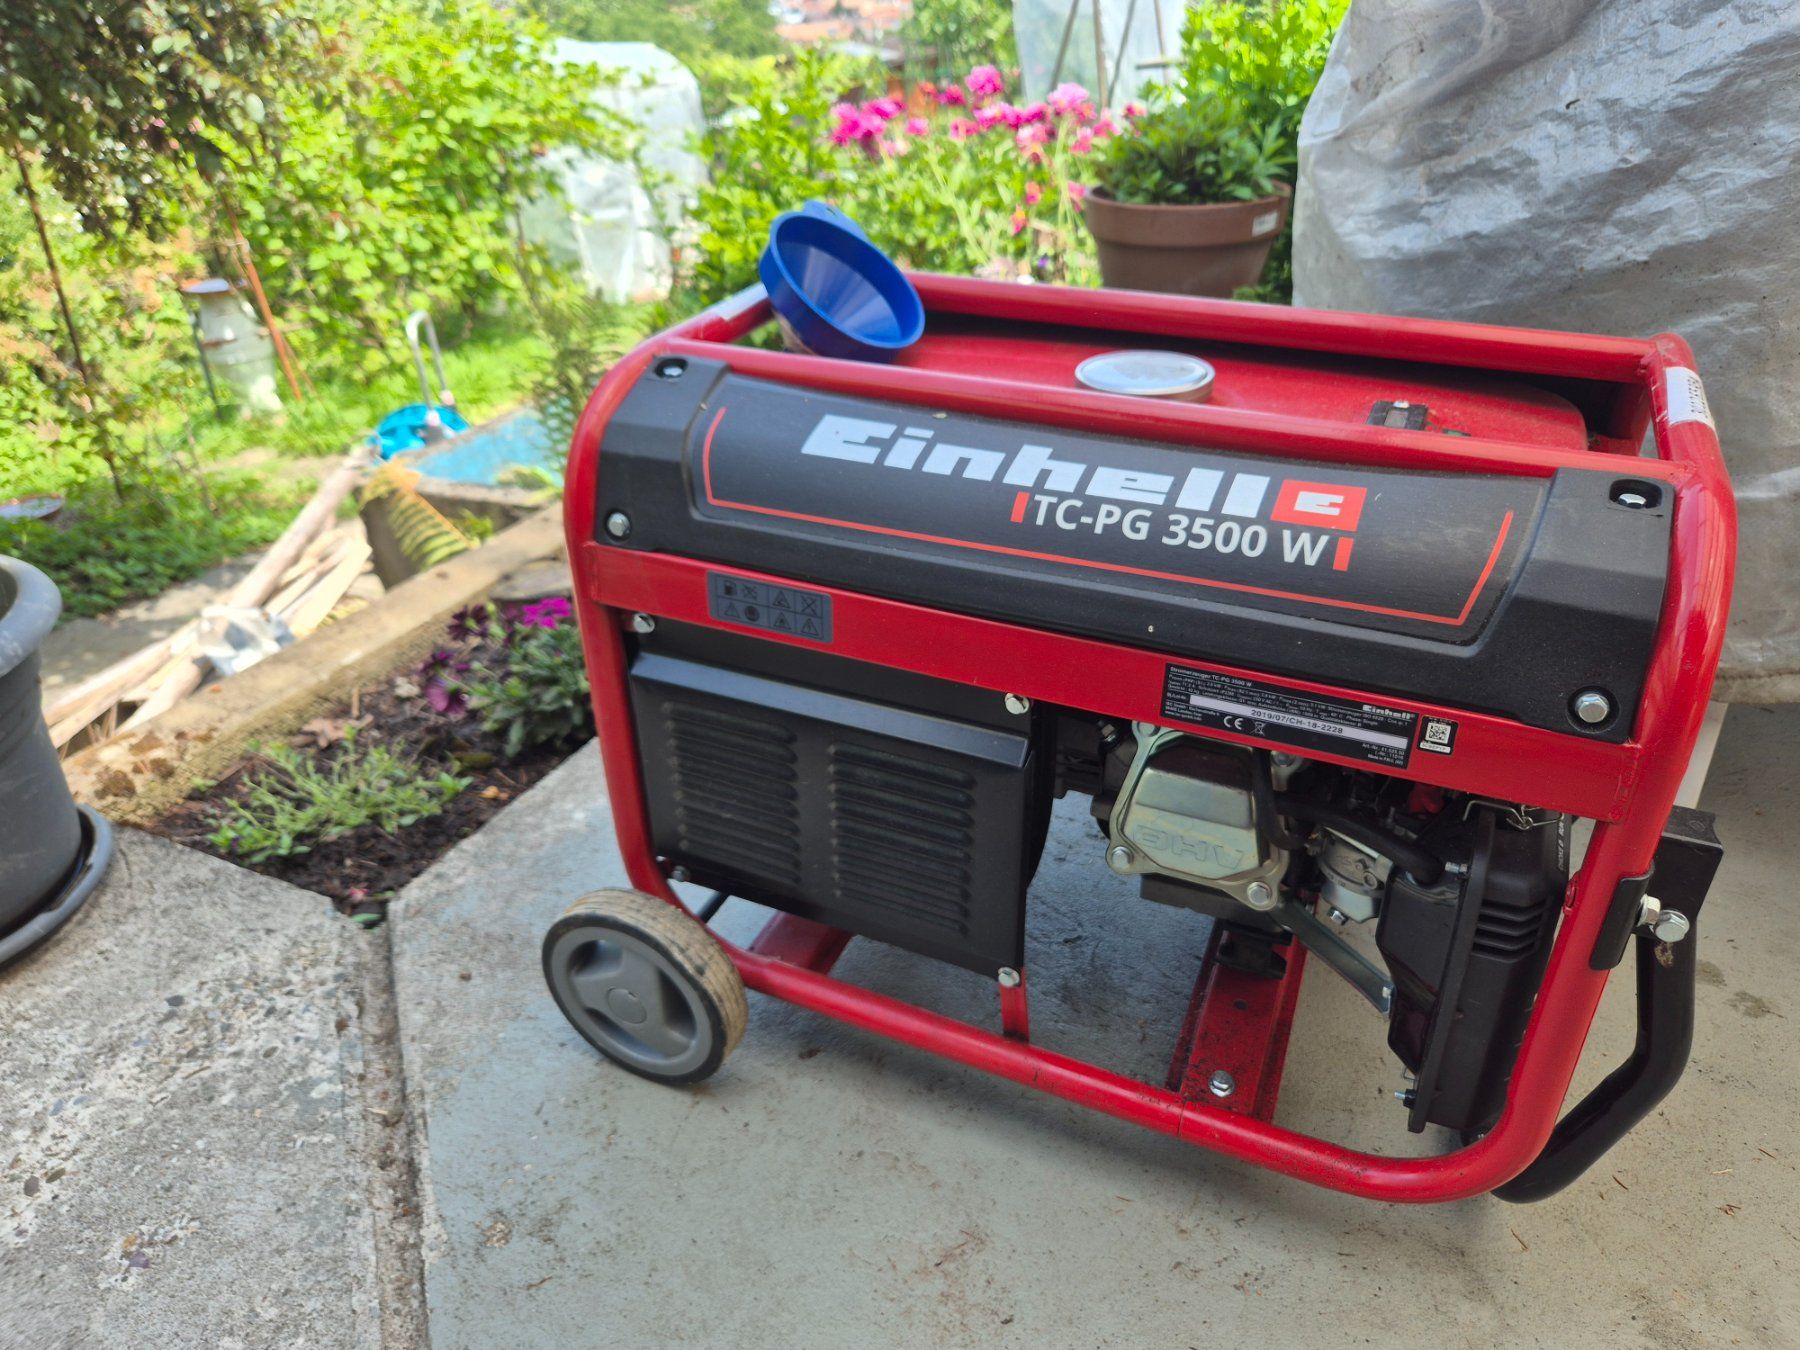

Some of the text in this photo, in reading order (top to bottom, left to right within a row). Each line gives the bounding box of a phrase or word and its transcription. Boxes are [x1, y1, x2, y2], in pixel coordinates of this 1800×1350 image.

[801, 413, 1270, 518] Einhell
[1032, 494, 1330, 567] TC-PG 3500 W
[1250, 709, 1343, 734] 2019/07/CH-18-2228
[1362, 704, 1411, 720] Einhell
